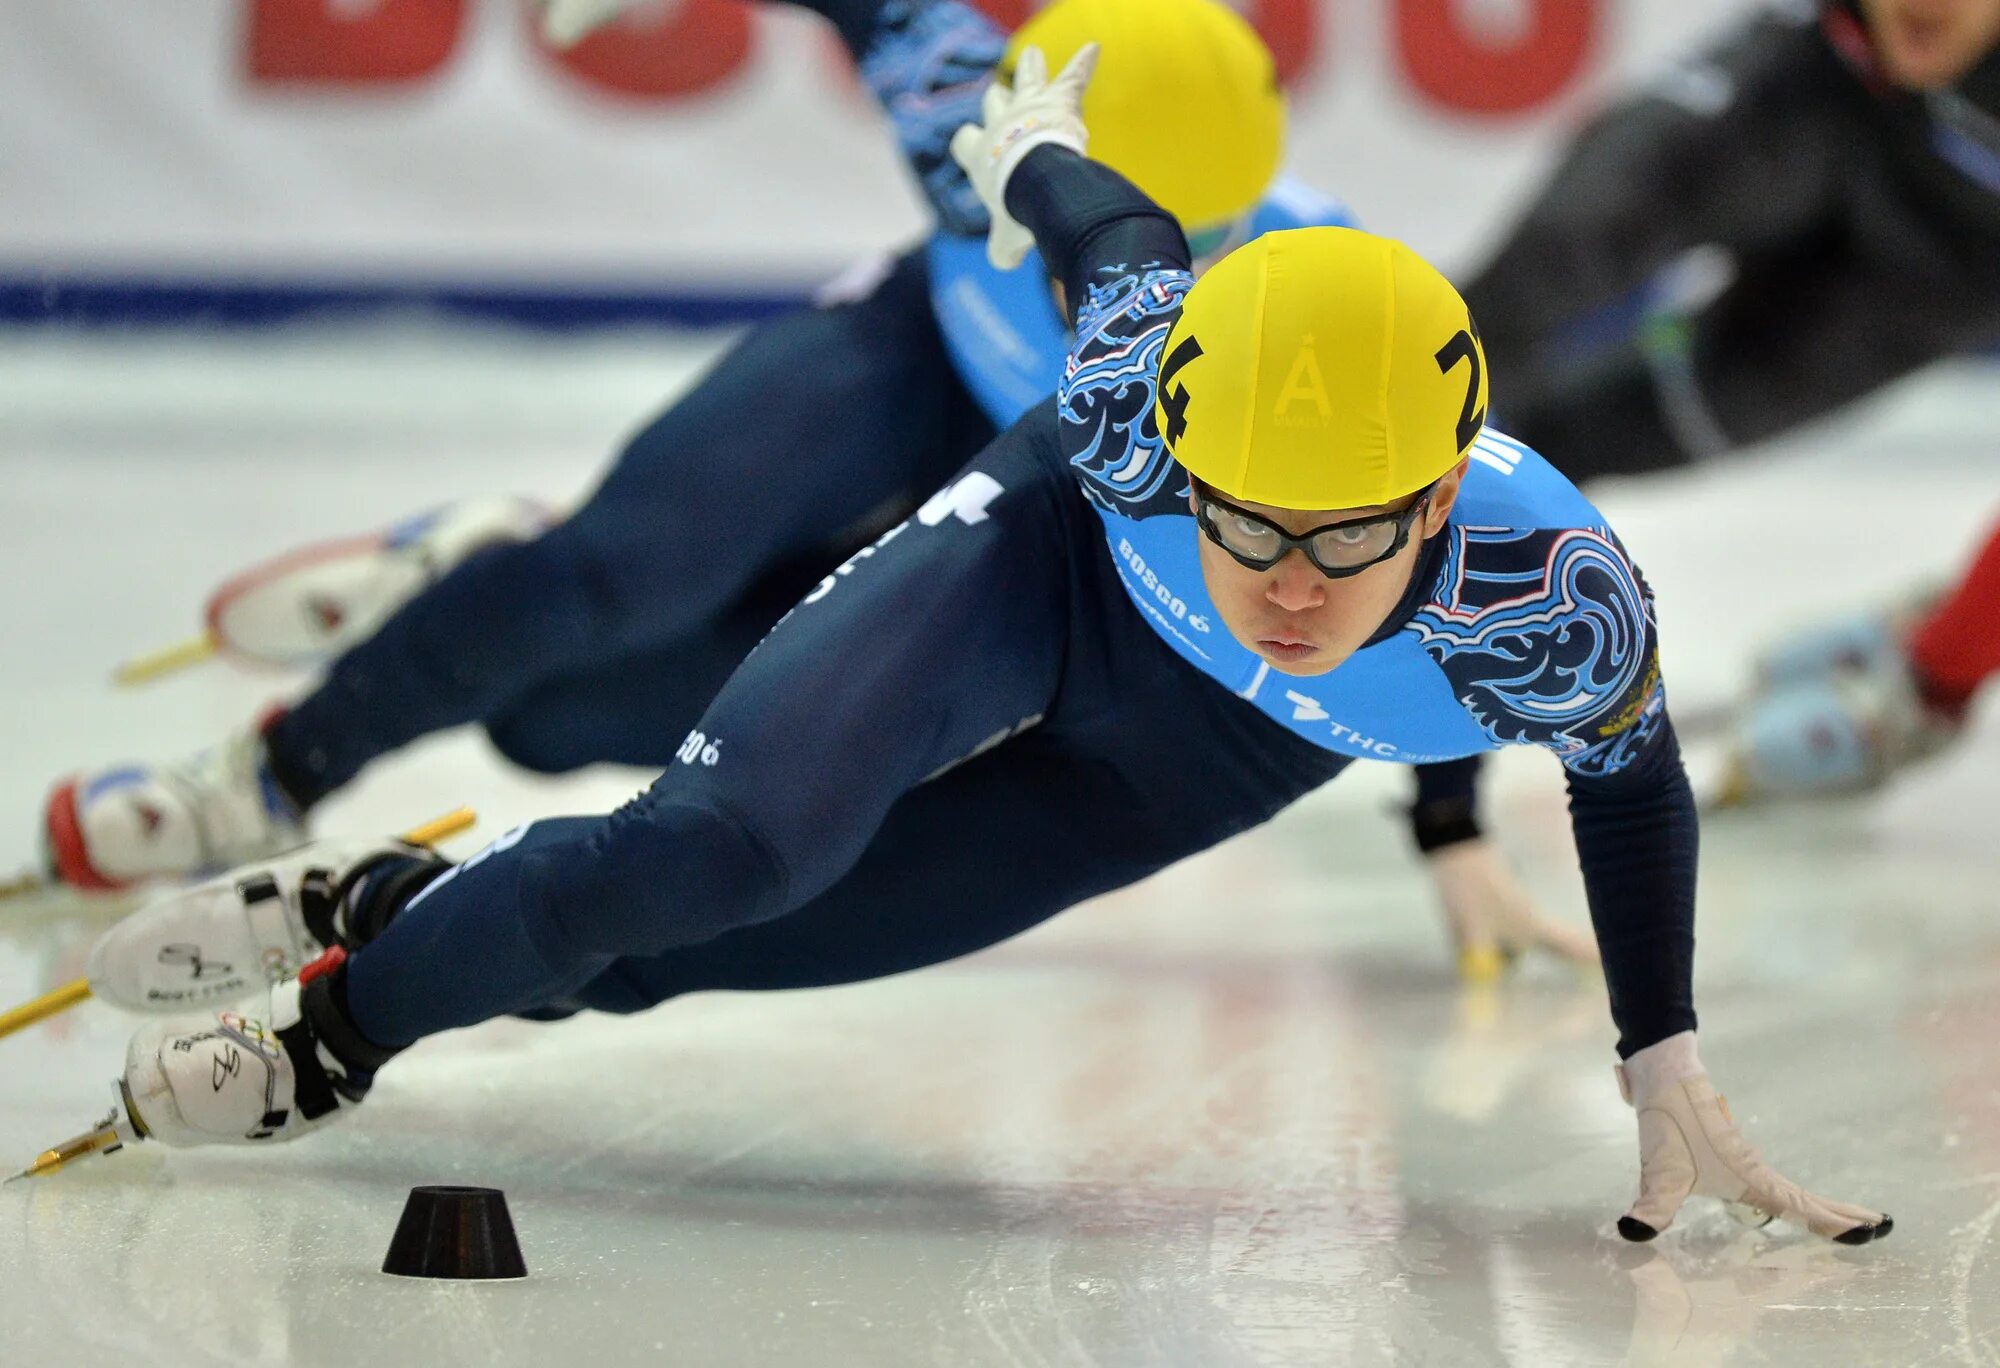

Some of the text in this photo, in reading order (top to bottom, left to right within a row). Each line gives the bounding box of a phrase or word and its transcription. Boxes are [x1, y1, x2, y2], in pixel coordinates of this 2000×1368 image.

[1158, 334, 1204, 450] 4
[1272, 349, 1332, 416] A
[1432, 330, 1486, 456] 2
[1118, 537, 1188, 621] BOSCO
